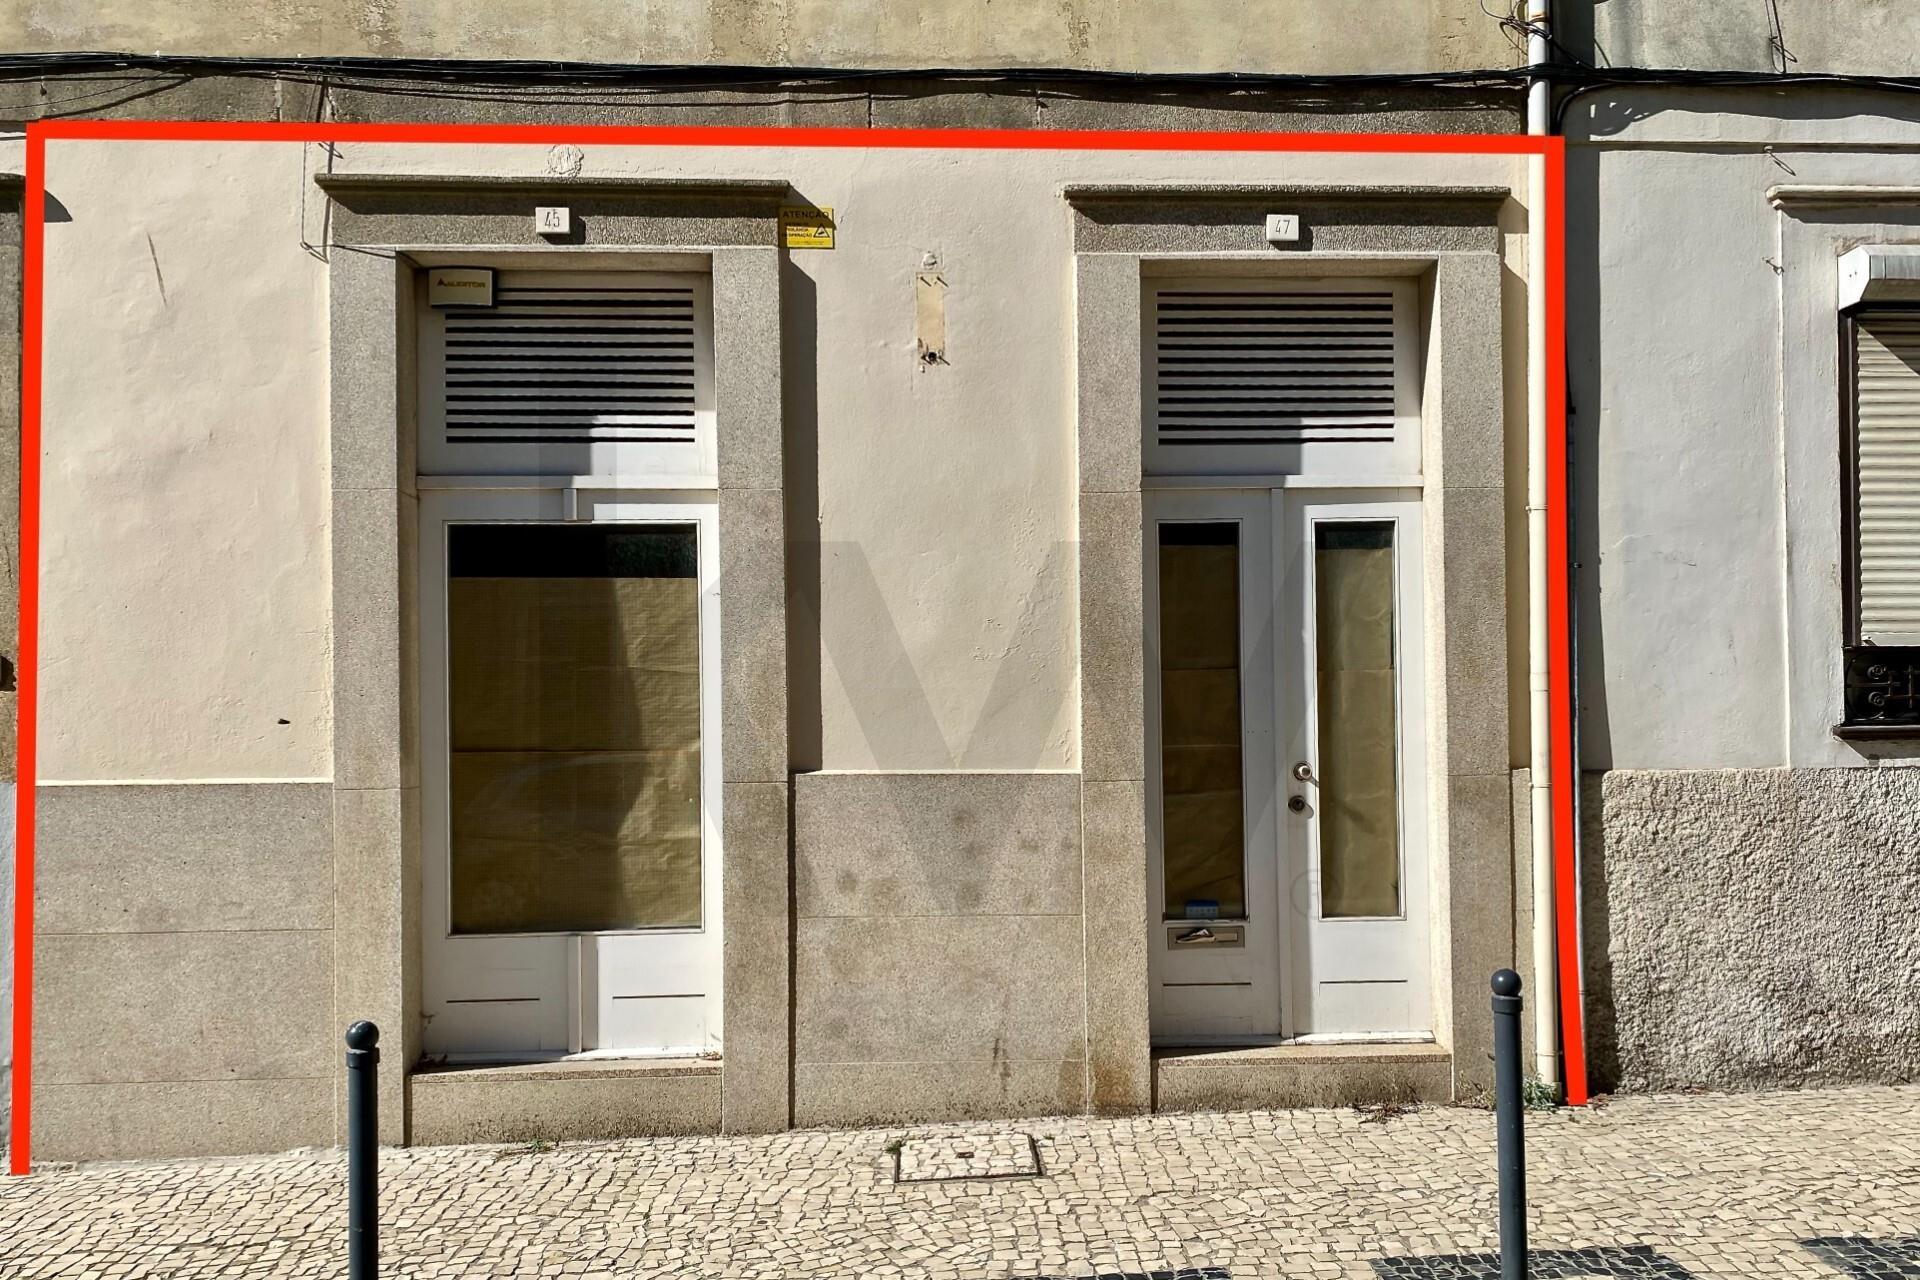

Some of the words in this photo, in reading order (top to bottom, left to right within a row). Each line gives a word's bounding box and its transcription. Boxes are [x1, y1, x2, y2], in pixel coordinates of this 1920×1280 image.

[544, 211, 560, 228] 45
[782, 210, 829, 219] ATENÇÃO
[1275, 219, 1291, 235] 47
